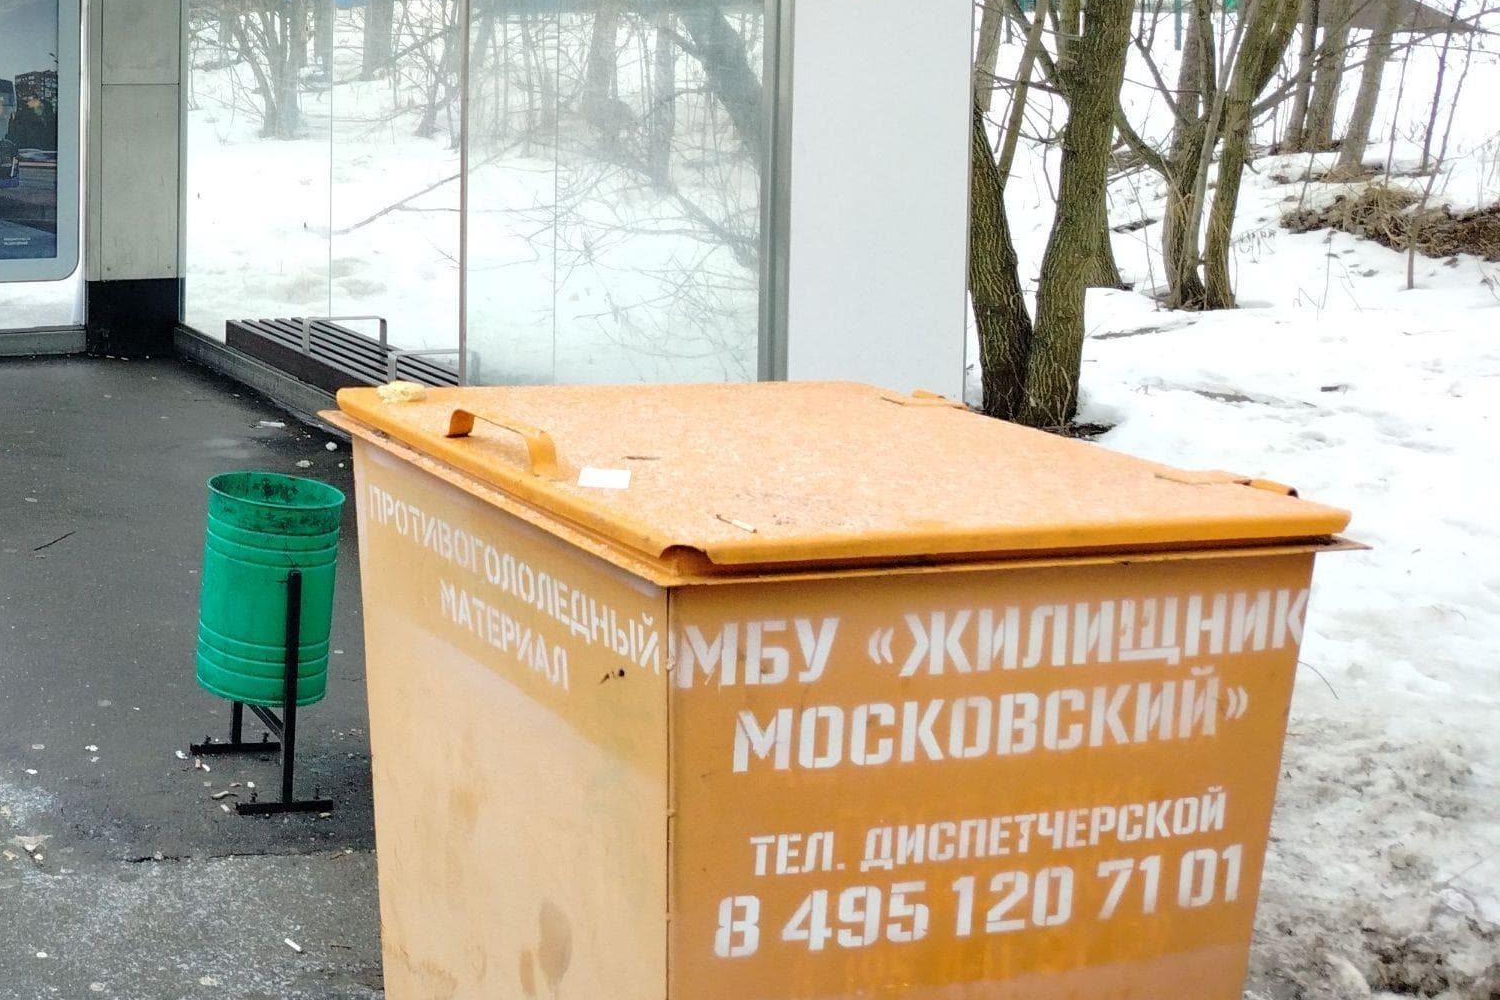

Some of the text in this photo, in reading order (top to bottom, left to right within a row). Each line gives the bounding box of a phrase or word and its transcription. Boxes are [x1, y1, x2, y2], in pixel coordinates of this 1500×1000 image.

[369, 484, 660, 675] ПРОТИВОГОЛОЛЕДНЫЙ
[439, 578, 569, 693] МАТЕРИАЛ
[676, 587, 1309, 689] МБУ «ЖИЛИЩНИК
[732, 665, 1249, 773] МОСКОВСКИЙ»
[750, 785, 1228, 877] ТЕЛ. ДИСПЕТЧЕРСКОЙ
[713, 843, 1243, 959] 8 495 120 71 01
